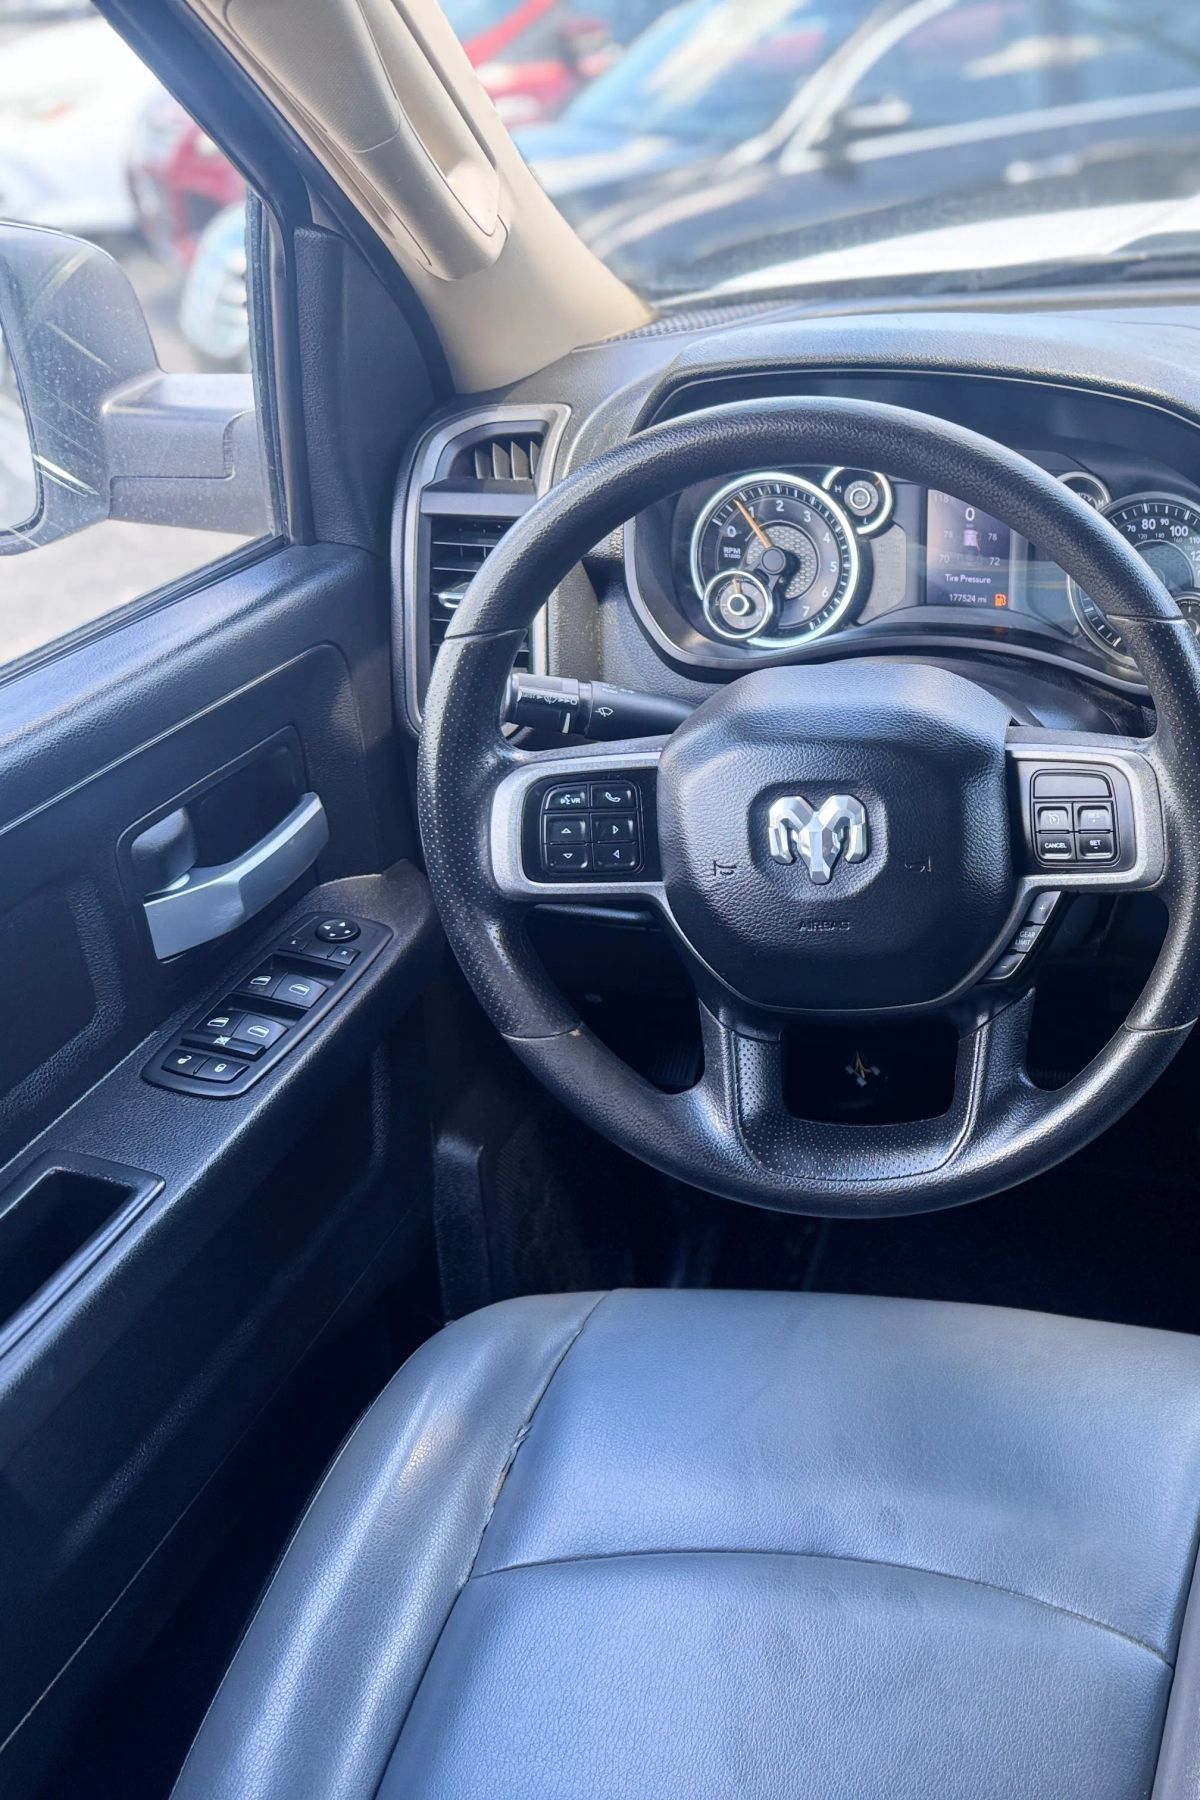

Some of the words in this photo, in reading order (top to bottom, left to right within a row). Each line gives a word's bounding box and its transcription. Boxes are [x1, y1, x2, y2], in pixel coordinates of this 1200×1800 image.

[835, 485, 842, 493] H
[776, 500, 784, 512] 2
[803, 510, 811, 523] 3
[965, 507, 975, 521] 0
[1141, 519, 1156, 530] 80
[1160, 518, 1169, 526] 90
[727, 525, 737, 538] 0
[1127, 524, 1137, 532] 70
[1169, 525, 1189, 537] 100
[823, 532, 830, 544] 4
[987, 532, 998, 542] 78
[1188, 536, 1200, 545] 110
[723, 546, 741, 555] RPM
[830, 561, 837, 572] 5
[989, 556, 1001, 567] 72
[945, 573, 959, 583] Tire
[960, 574, 992, 585] Pressure
[821, 587, 829, 597] 6
[949, 593, 976, 604] 177524
[802, 606, 810, 617] 7
[1020, 930, 1036, 938] GEAR
